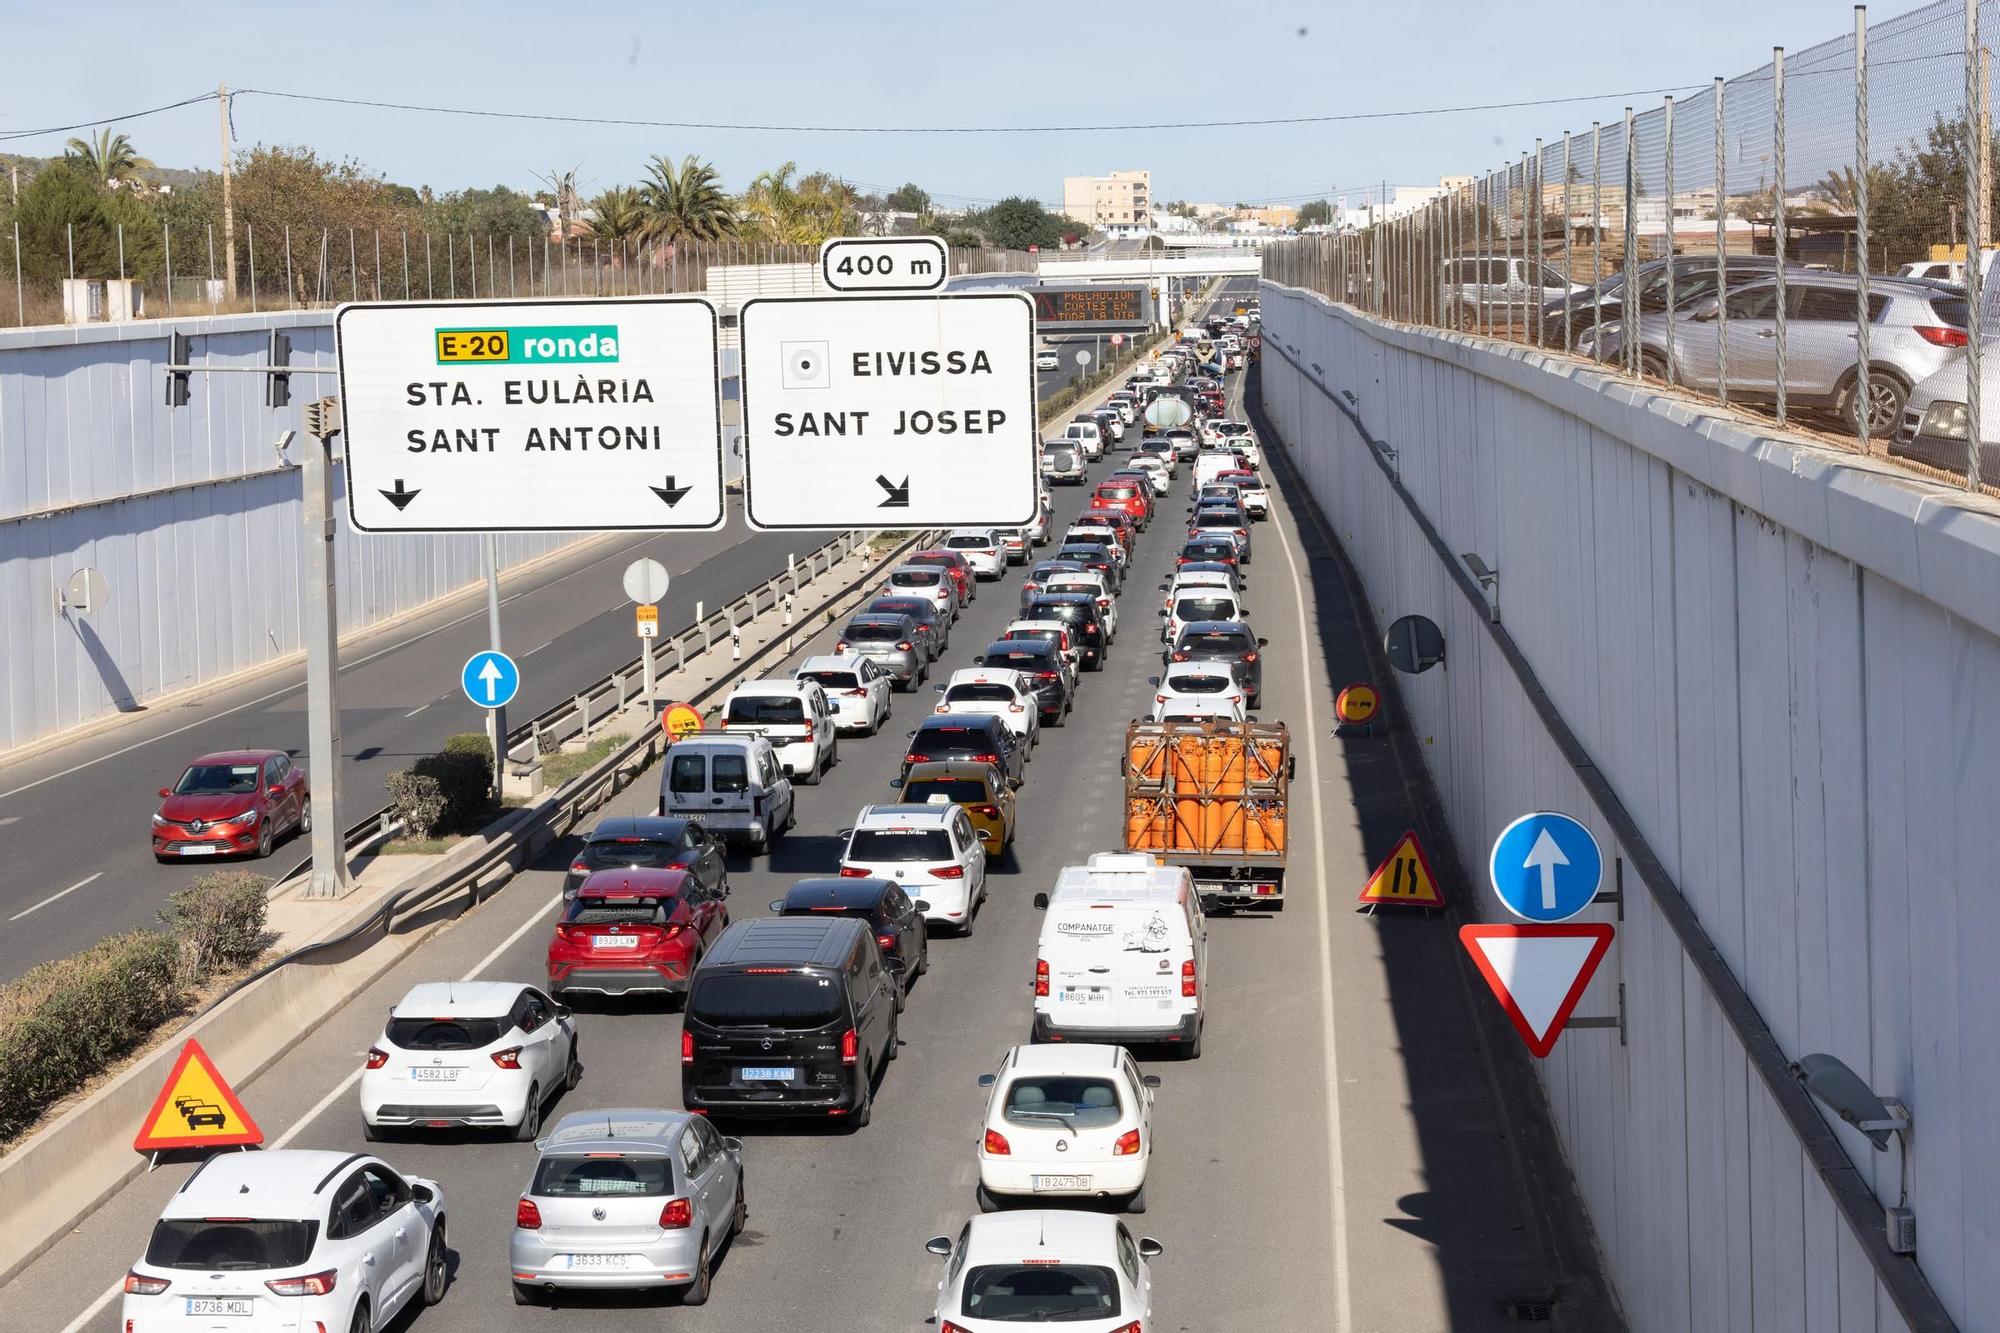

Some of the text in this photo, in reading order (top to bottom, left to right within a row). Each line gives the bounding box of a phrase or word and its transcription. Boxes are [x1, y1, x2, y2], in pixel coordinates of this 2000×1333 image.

[836, 255, 932, 275] 400 m
[1064, 301, 1127, 311] CORTES EN
[1058, 311, 1135, 321] TODA LA VIA
[442, 333, 618, 358] E-20 ronda
[853, 350, 992, 377] EIVISSA
[406, 373, 655, 406] STA. EULÀRIA
[774, 409, 1006, 437] SANT JOSEP
[406, 425, 661, 453] SANT ANTONI
[644, 626, 652, 636] 3
[1057, 922, 1114, 932] COMPANATGE
[598, 936, 619, 945] 8929
[1065, 992, 1086, 1001] 8605
[417, 1069, 461, 1079] 4582 LBF
[1052, 1177, 1075, 1187] 2475
[1076, 1177, 1088, 1187] DB
[575, 1255, 626, 1266] 3633 KCS
[194, 1301, 248, 1313] 8736 MDL
